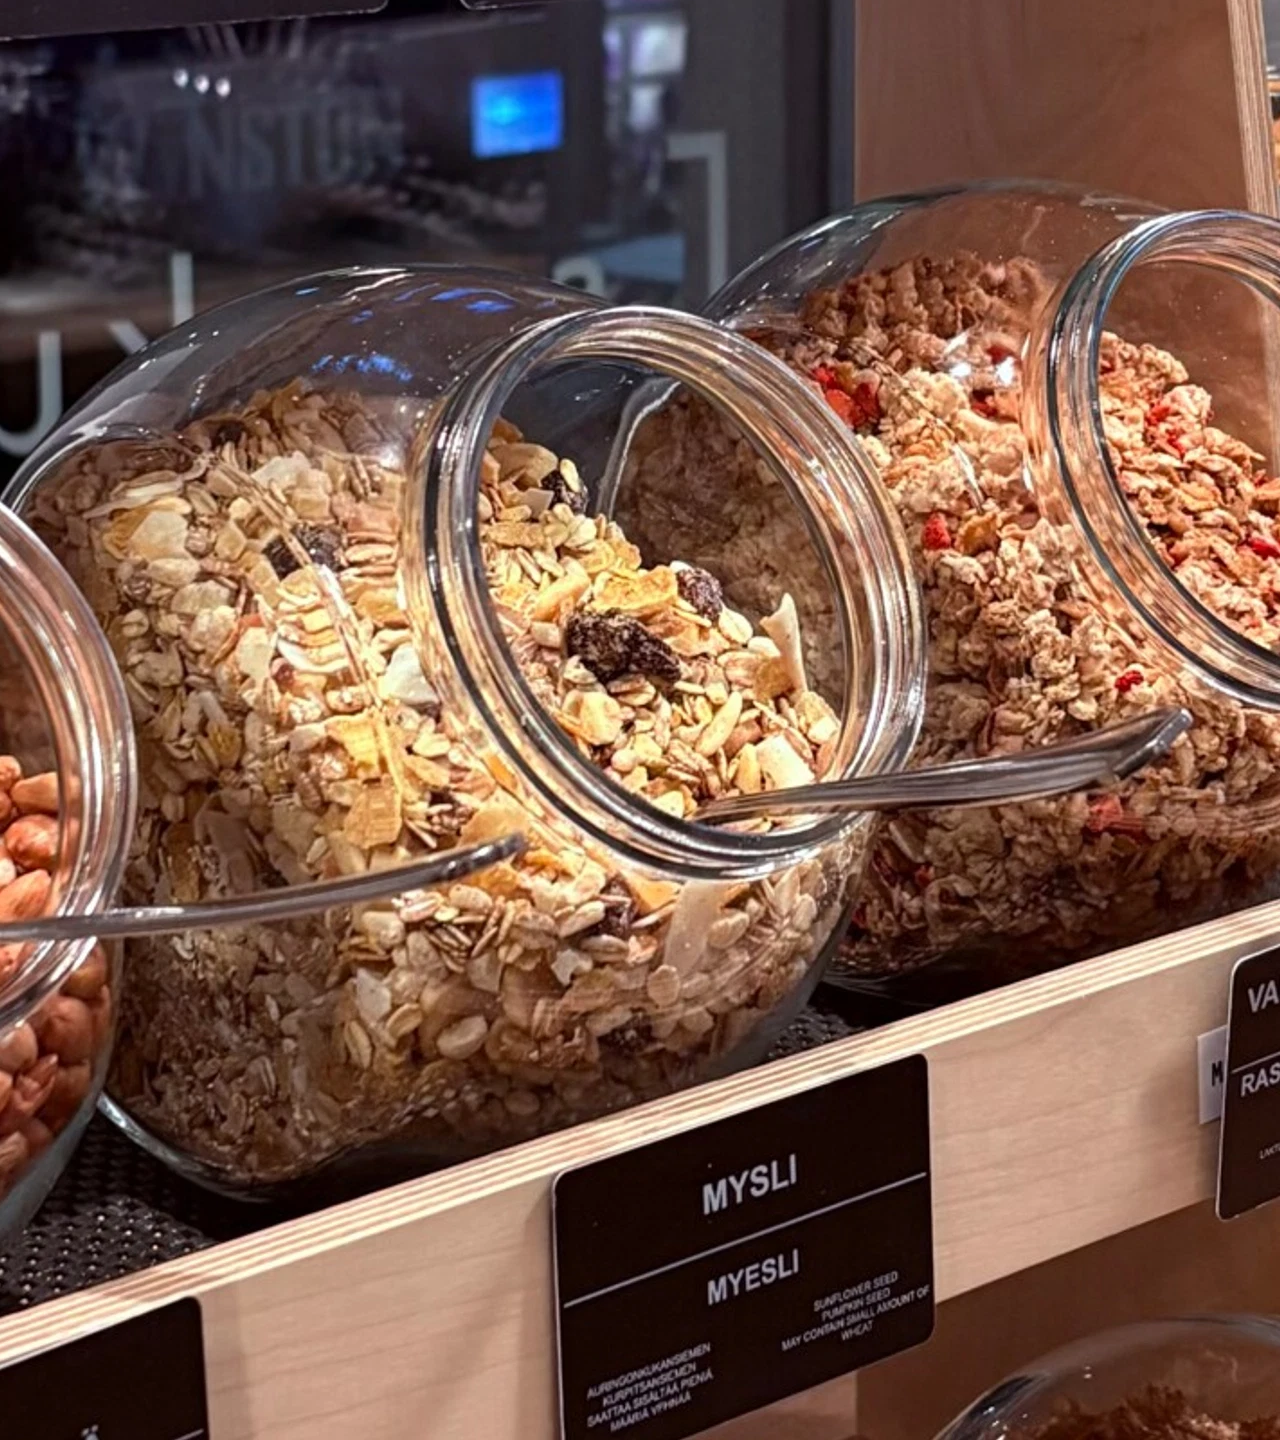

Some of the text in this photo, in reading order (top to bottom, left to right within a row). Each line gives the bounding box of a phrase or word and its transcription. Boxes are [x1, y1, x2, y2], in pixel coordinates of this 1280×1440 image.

[702, 1154, 797, 1215] MYSLI
[707, 1248, 800, 1306] MYESLI
[813, 1270, 899, 1312] SUNFLOWER SEED
[781, 1284, 930, 1352] MAY CONTAIN SMALL AMOUNT OF
[821, 1287, 891, 1322] PUMPKIN SEED
[840, 1320, 874, 1341] WHEAT
